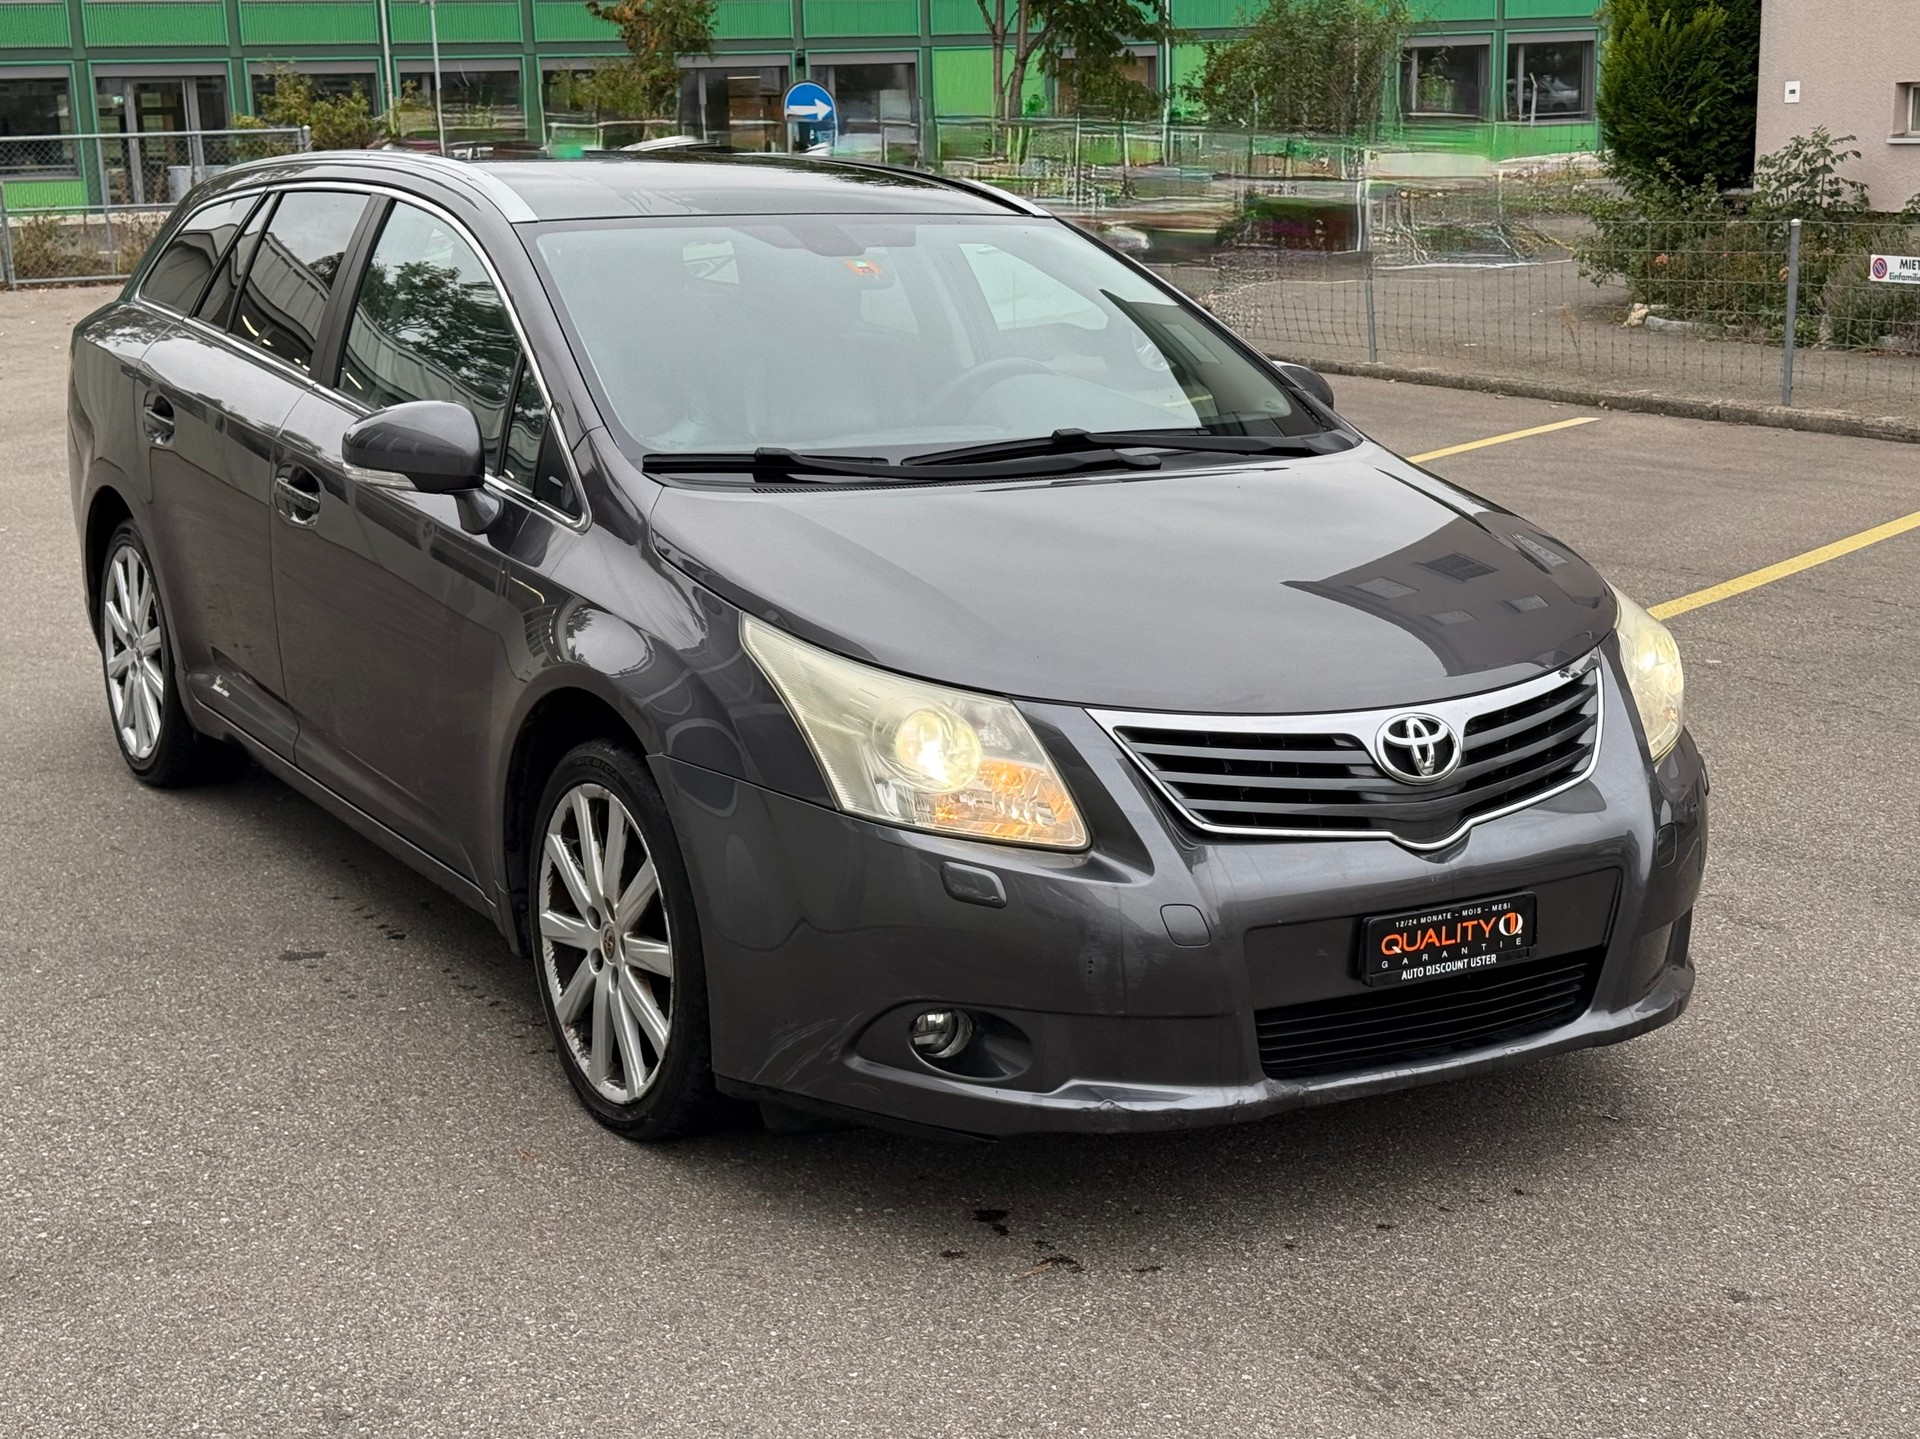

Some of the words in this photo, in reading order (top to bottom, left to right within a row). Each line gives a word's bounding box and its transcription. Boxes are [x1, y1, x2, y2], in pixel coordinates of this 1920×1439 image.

[1395, 918, 1417, 928] 12/24
[1420, 912, 1452, 924] MONATE
[1461, 907, 1482, 917] MOIS
[1491, 902, 1511, 911] MESI
[1381, 916, 1497, 955] QUALITY
[1381, 937, 1522, 969] GARANTIE
[1401, 967, 1424, 981] AUTO
[1426, 958, 1469, 976] DISCOUNT
[1470, 954, 1497, 968] USTER
